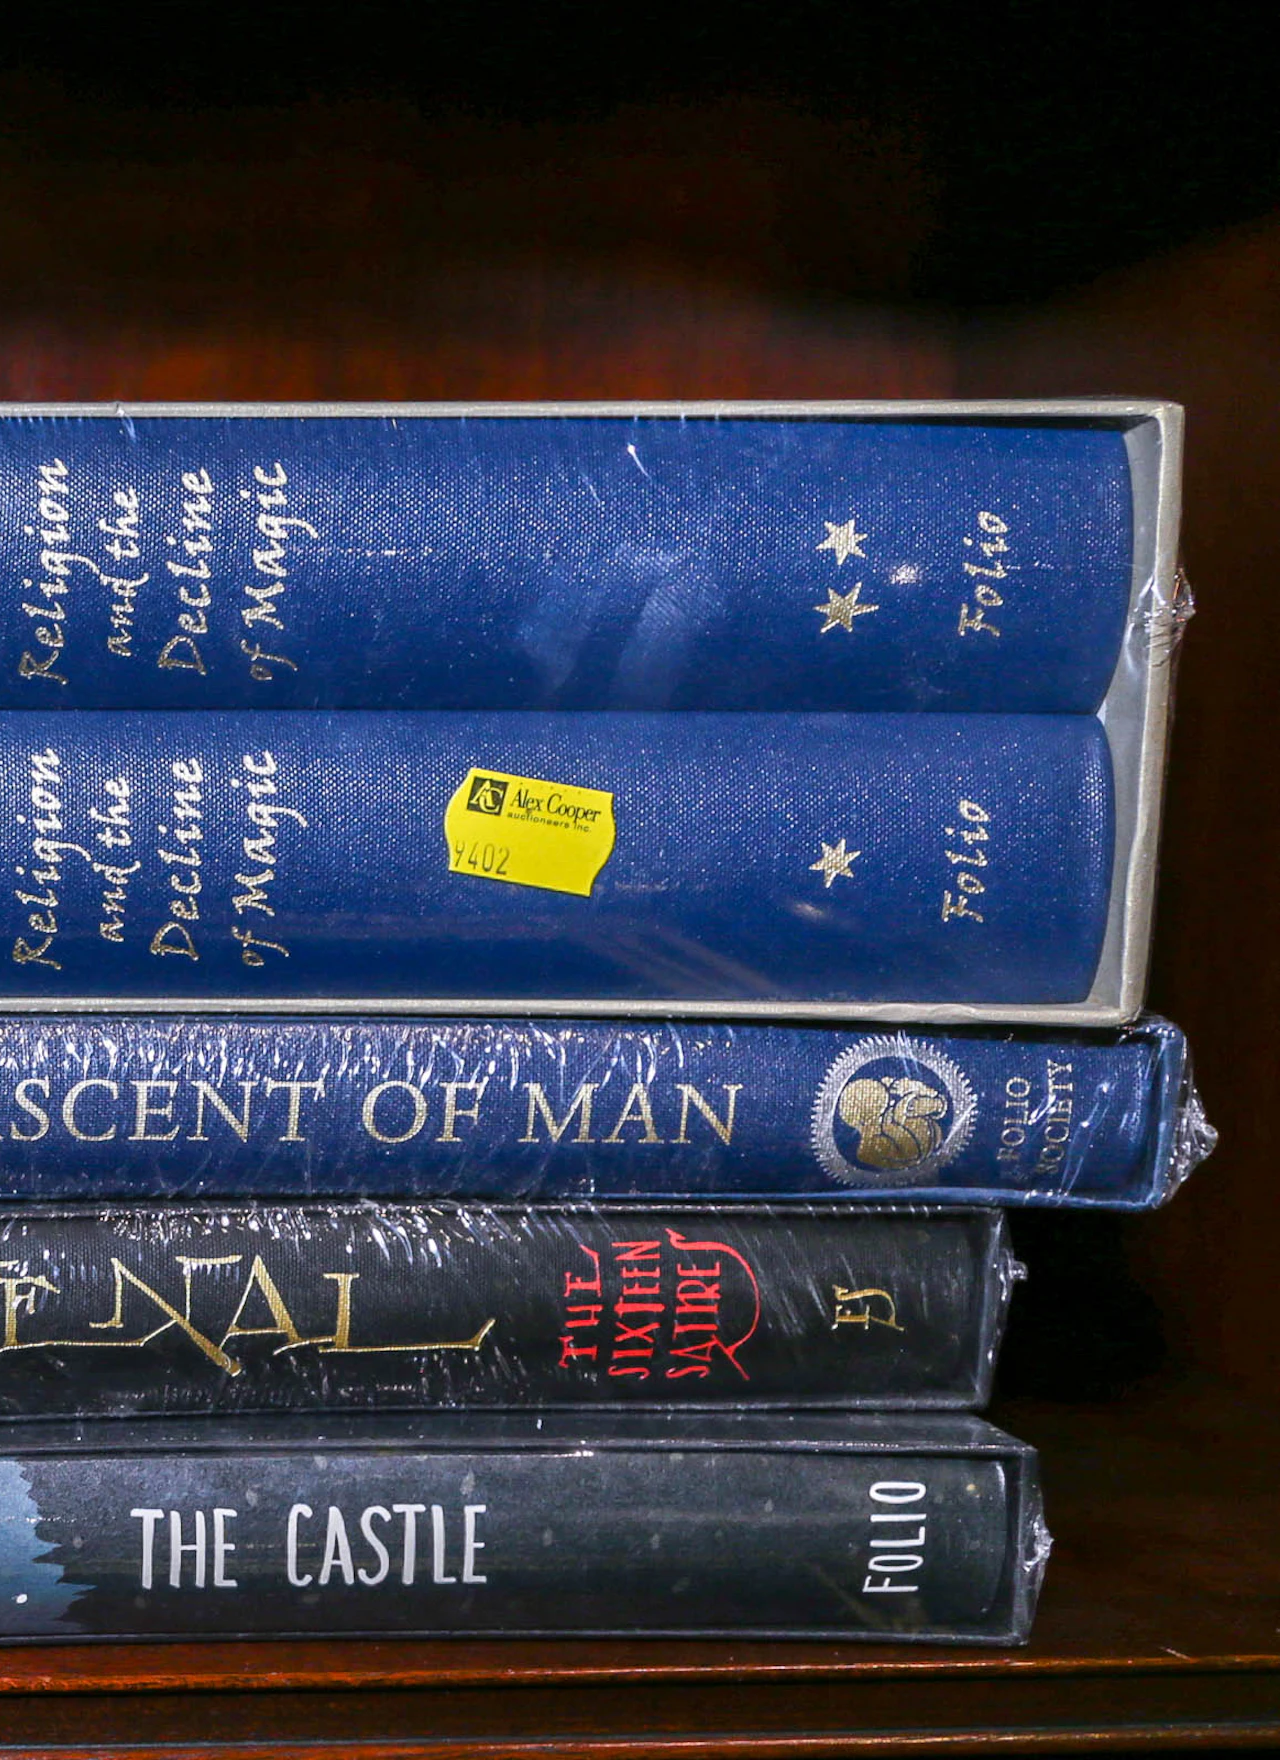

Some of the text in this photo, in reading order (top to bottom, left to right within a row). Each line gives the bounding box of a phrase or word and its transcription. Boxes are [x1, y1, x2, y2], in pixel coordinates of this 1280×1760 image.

[18, 457, 101, 685] Religion
[98, 486, 150, 658] and the
[157, 466, 214, 676] Decline
[239, 461, 319, 681] of Magic
[957, 509, 1010, 638] Folio
[12, 747, 92, 971] Religion
[87, 776, 142, 943] and the
[150, 757, 204, 962] Decline
[231, 750, 309, 967] of Magic
[454, 839, 511, 876] 9402
[507, 811, 570, 829] auctioneers
[510, 788, 602, 824] Alex Cooper
[940, 798, 990, 923] Folio
[362, 1078, 486, 1145] OF
[523, 1082, 745, 1147] MAN
[558, 1243, 604, 1369] THE
[607, 1240, 666, 1381] SIXTEEN
[664, 1227, 761, 1382] SATIRES
[130, 1503, 488, 1590] THE CASTLE
[862, 1480, 927, 1594] FOLIO
